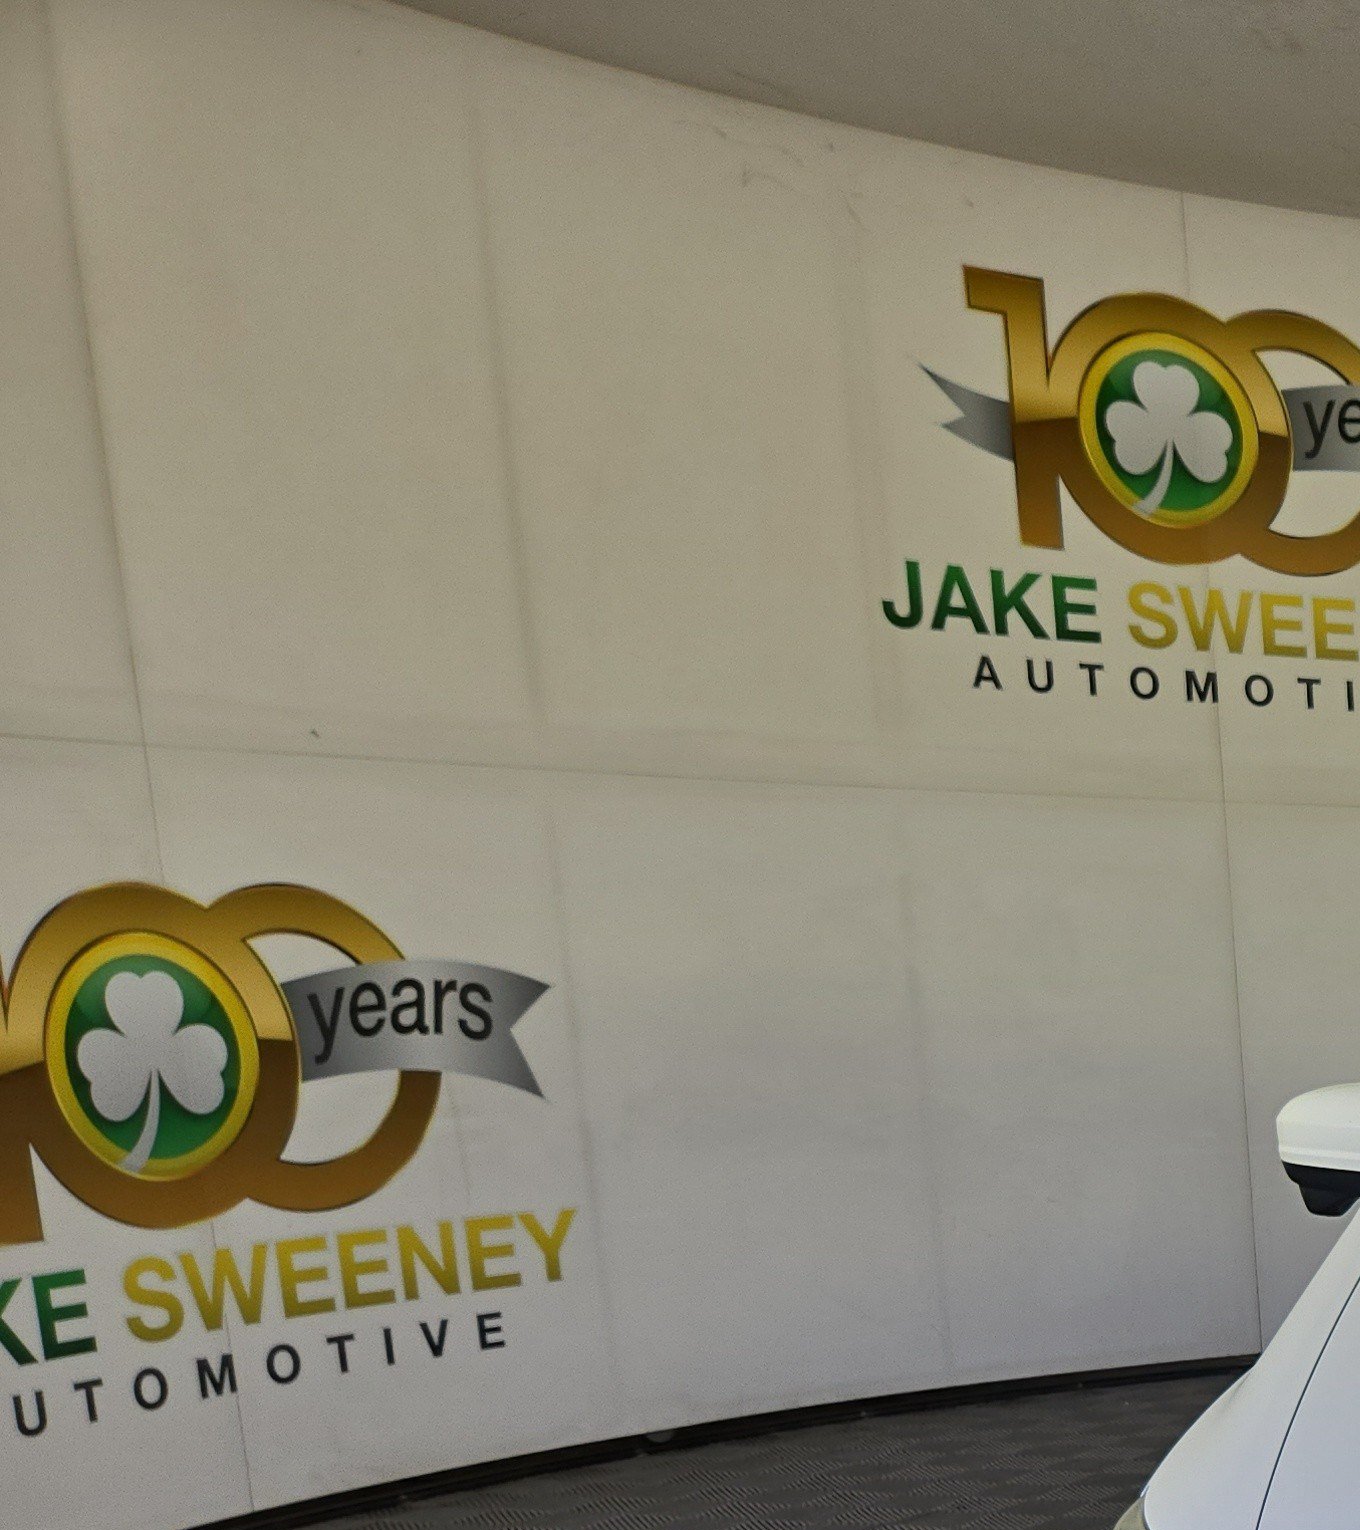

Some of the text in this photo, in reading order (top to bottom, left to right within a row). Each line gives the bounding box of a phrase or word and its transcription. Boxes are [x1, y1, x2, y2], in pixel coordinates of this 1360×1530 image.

[882, 559, 1102, 644] JAKE
[307, 975, 494, 1066] years
[121, 1207, 578, 1343] SWEENEY
[12, 1311, 506, 1437] UTOMOTIVE
